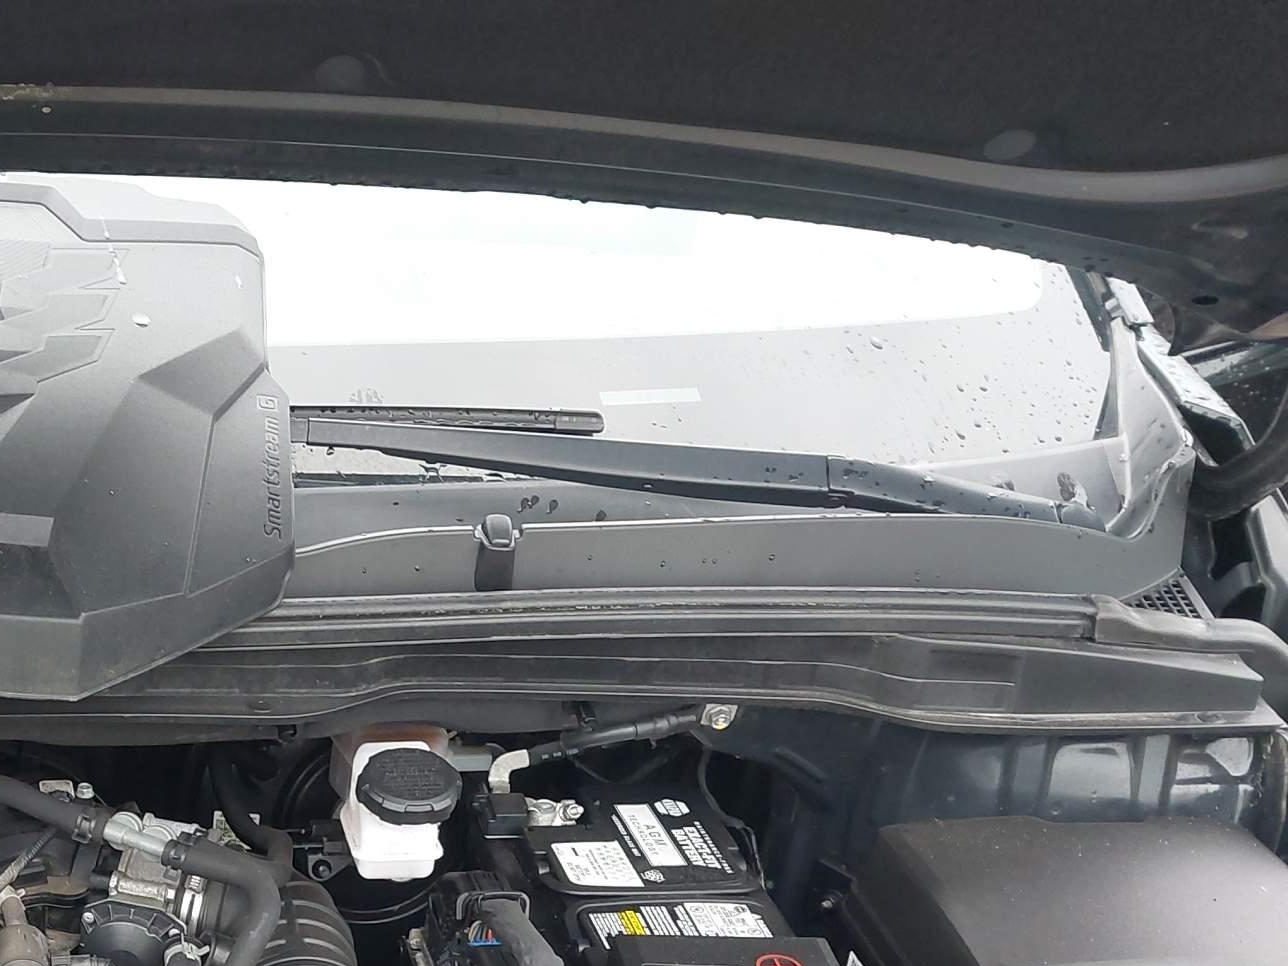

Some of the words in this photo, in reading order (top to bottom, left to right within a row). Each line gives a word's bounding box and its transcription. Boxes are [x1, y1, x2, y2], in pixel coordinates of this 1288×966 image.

[262, 415, 282, 541] Smartstream
[627, 815, 660, 856] TECHNOLOGY
[643, 824, 667, 846] AGM
[671, 829, 707, 867] BATTERY
